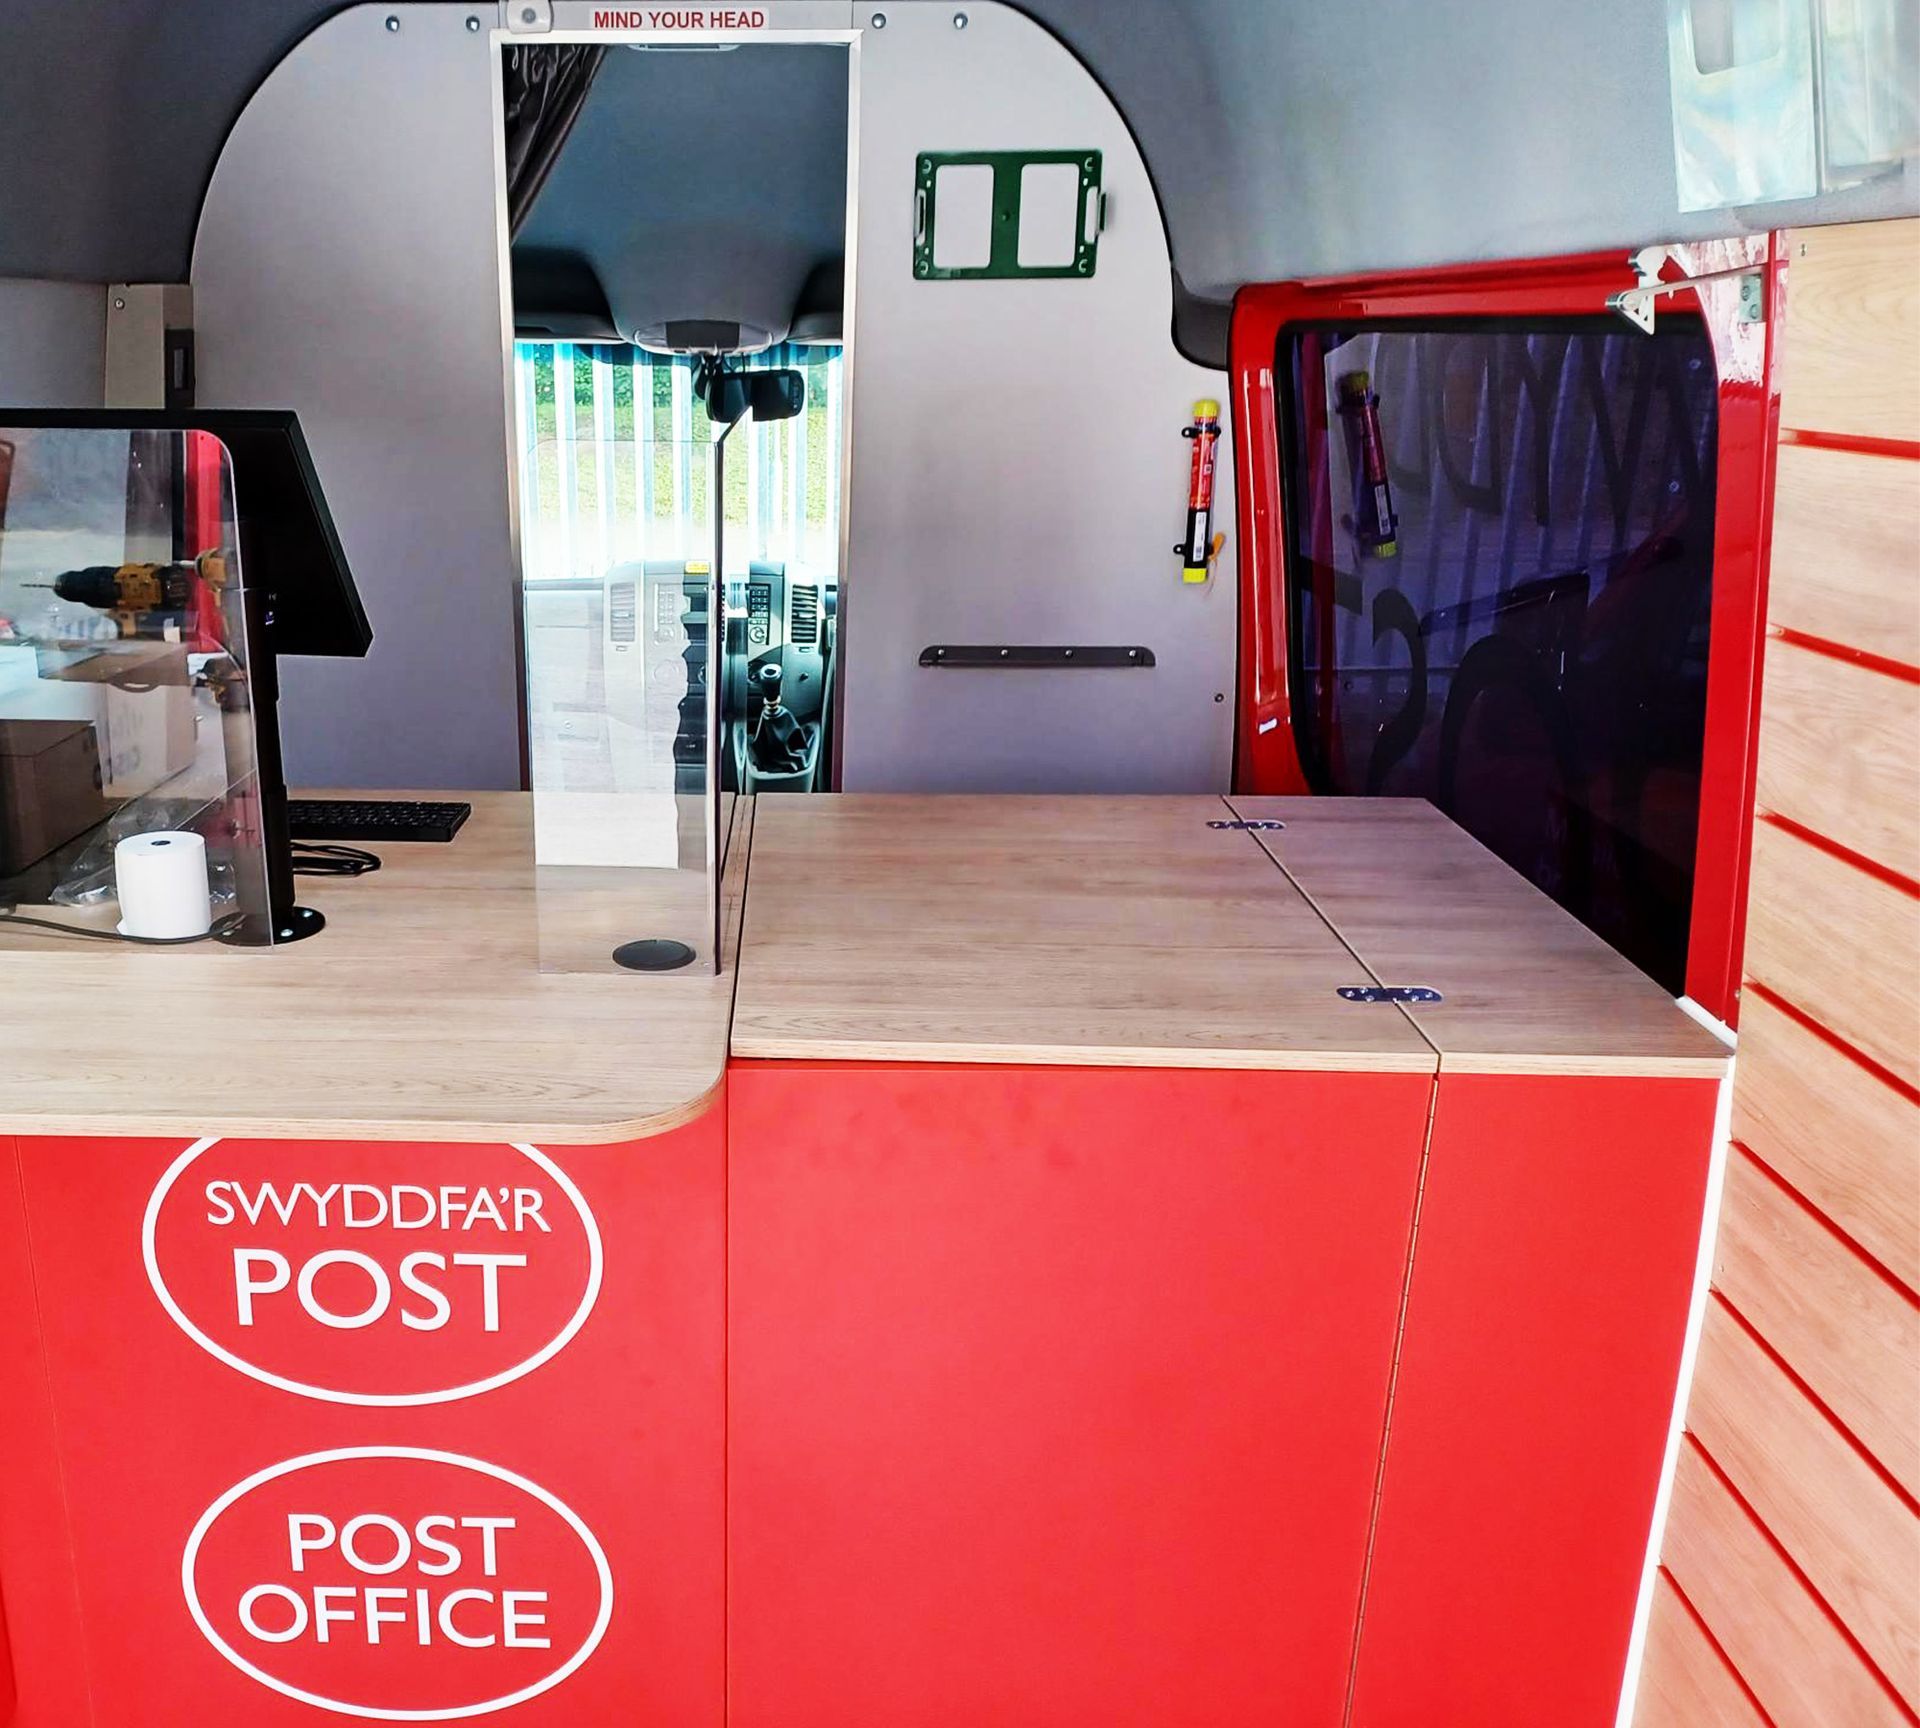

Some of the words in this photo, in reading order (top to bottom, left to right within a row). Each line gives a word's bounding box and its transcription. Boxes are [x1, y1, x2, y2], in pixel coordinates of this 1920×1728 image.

[594, 11, 642, 28] MIND
[649, 11, 704, 28] YOUR
[710, 11, 764, 28] HEAD
[205, 1180, 551, 1232] SWYDDFA’R
[233, 1248, 527, 1332] POST
[288, 1514, 515, 1575] POST
[238, 1583, 551, 1649] OFFICE
